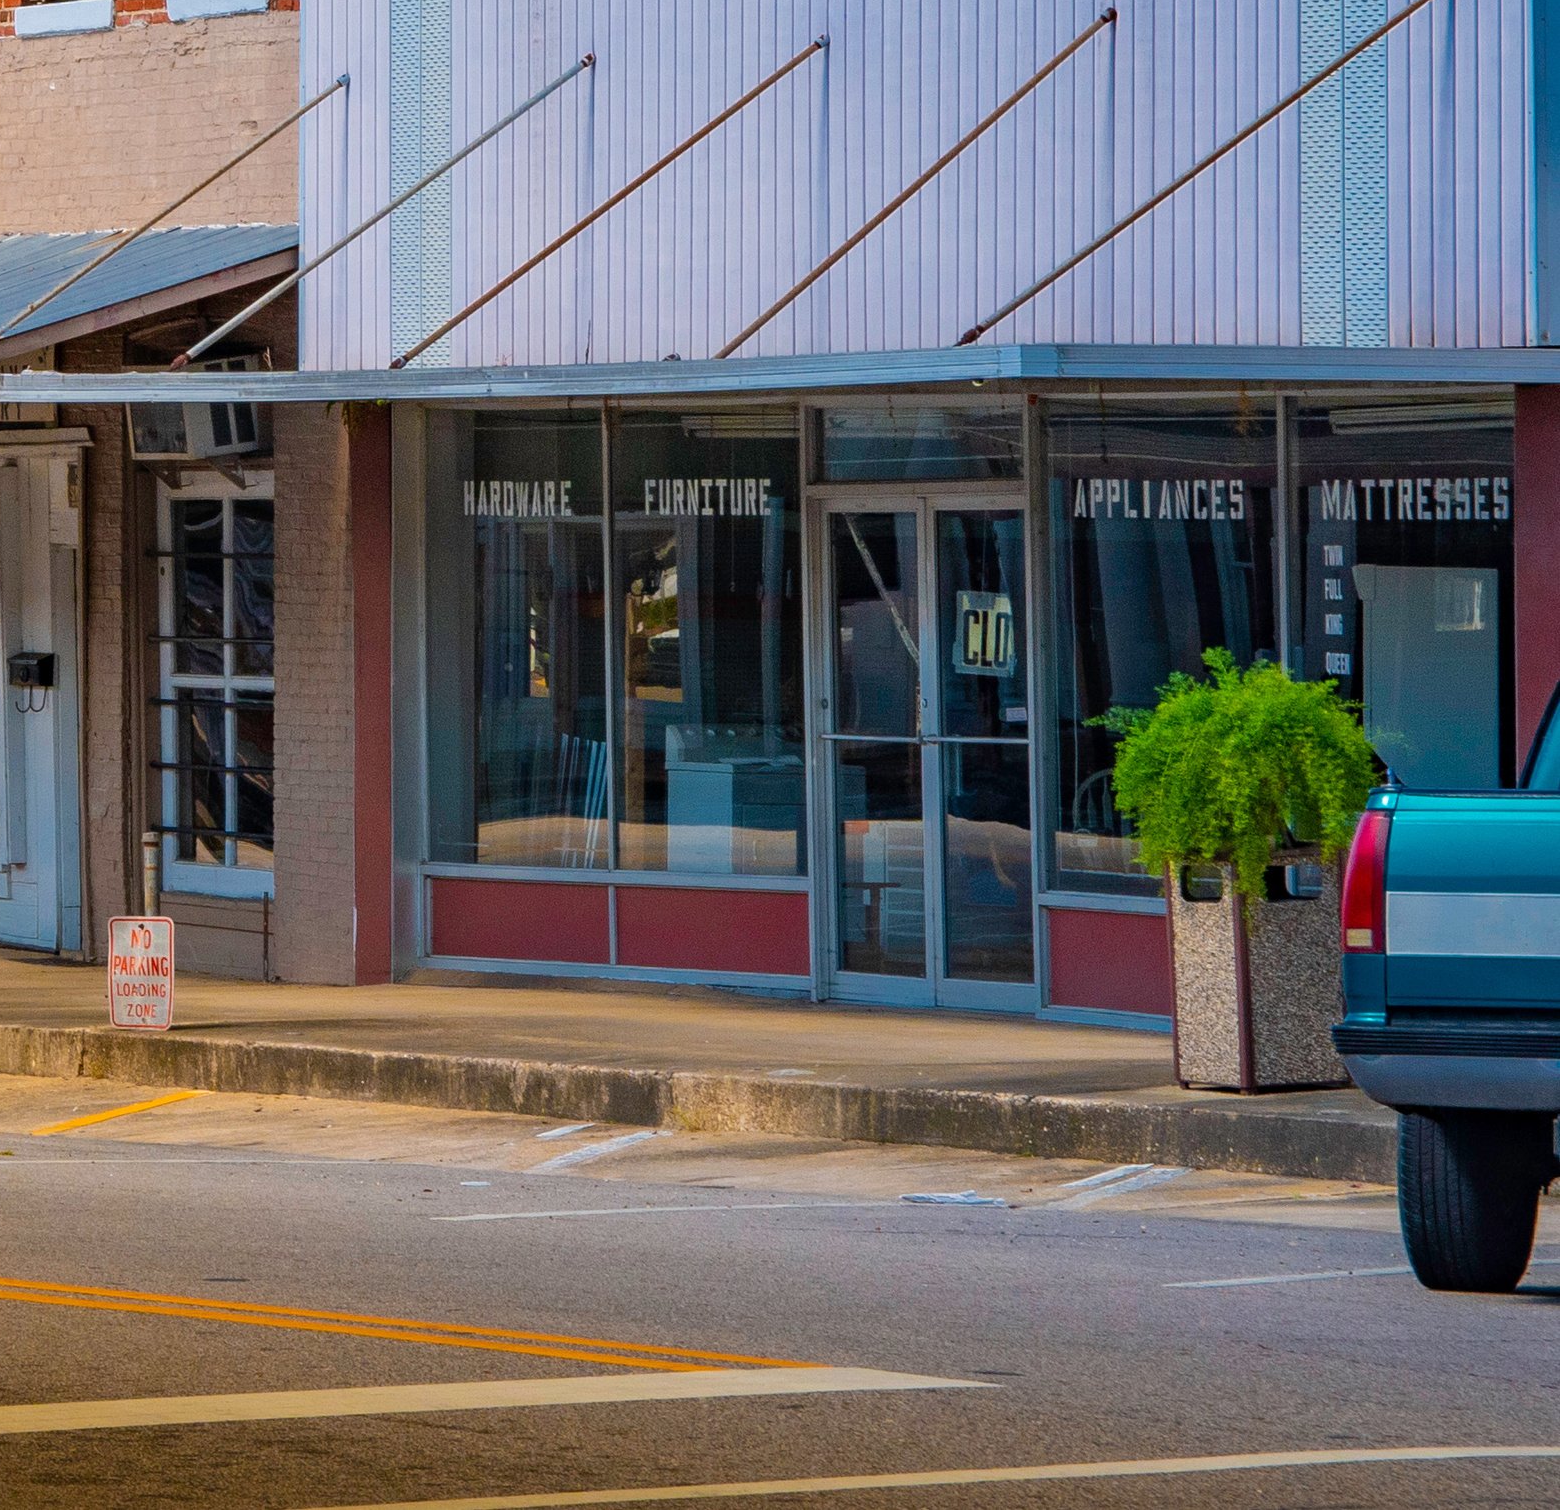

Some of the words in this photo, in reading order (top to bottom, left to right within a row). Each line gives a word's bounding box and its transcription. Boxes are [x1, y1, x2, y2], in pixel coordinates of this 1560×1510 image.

[464, 480, 573, 517] HARDWARE
[644, 478, 771, 516] FURNITURE
[1074, 478, 1244, 520] APPLIANCES
[1322, 477, 1510, 521] MATTRESSES
[1324, 578, 1343, 600] FULL
[130, 929, 152, 950] NO
[113, 955, 169, 977] PARKING
[116, 982, 167, 999] LOADING
[126, 1003, 157, 1018] ZONE
